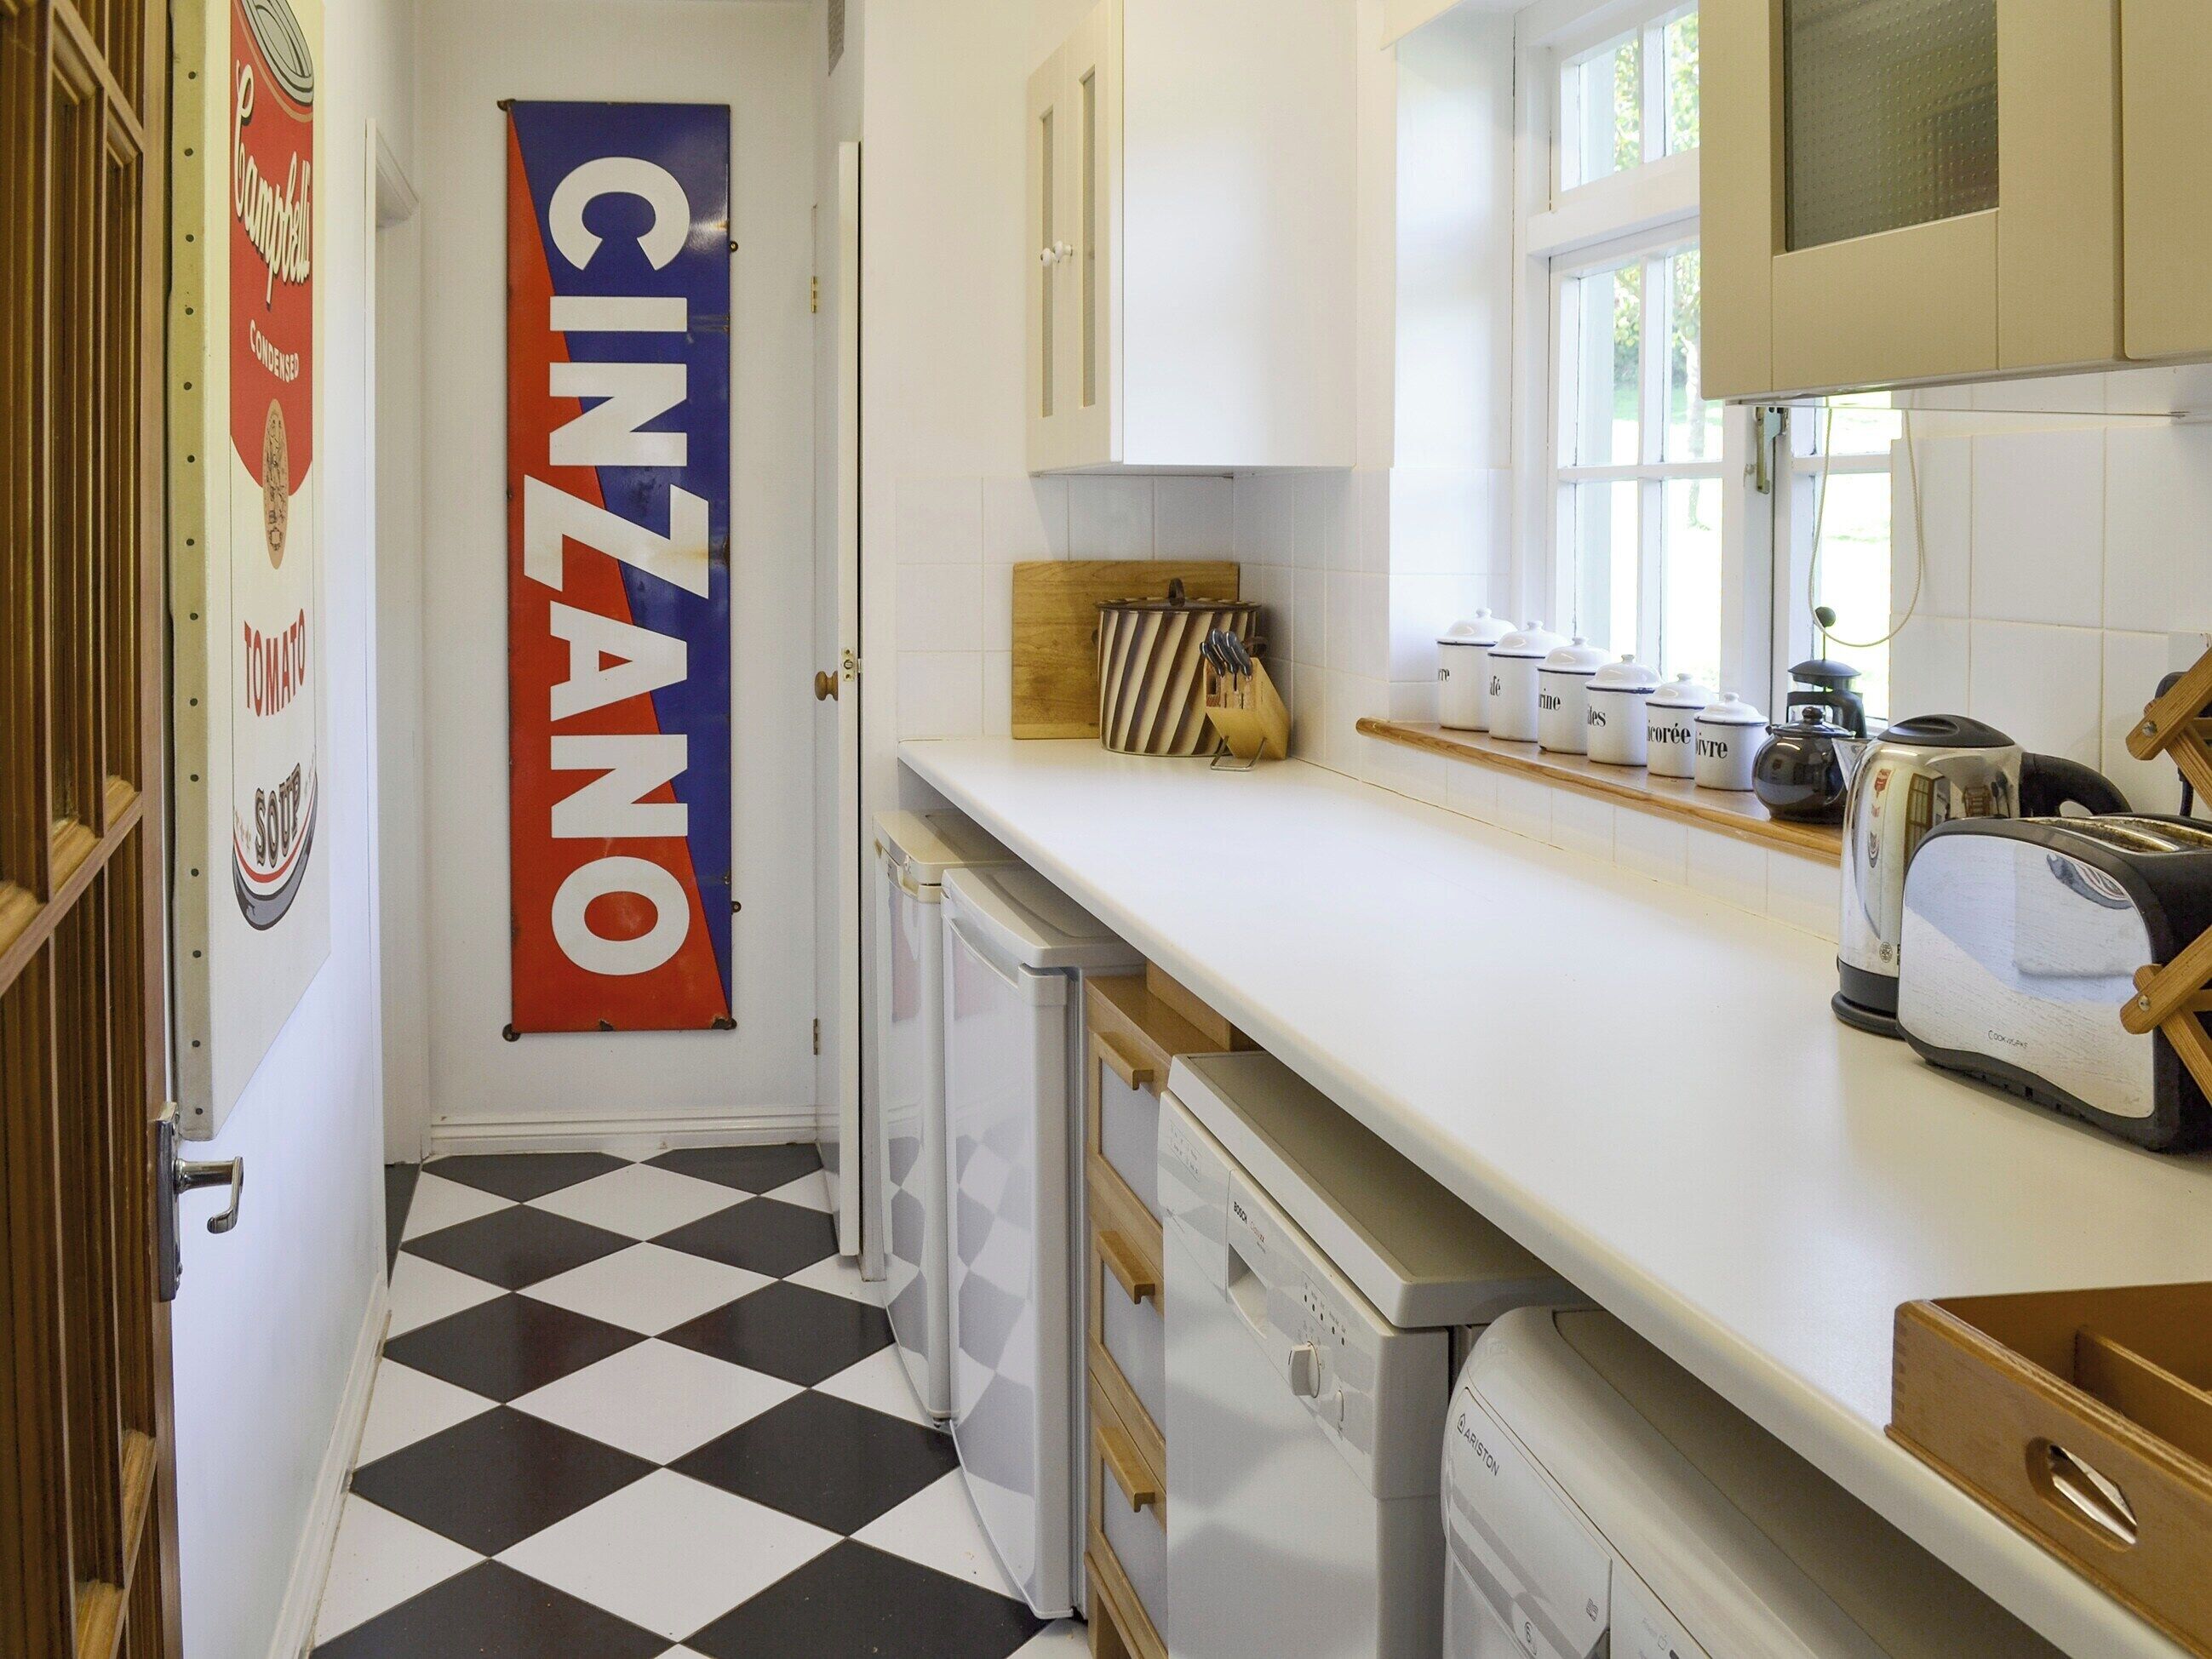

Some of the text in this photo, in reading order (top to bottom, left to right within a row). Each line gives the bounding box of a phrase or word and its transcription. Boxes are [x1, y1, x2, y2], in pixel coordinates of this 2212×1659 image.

[249, 319, 300, 383] CONDENSED
[524, 156, 709, 975] CINZANO
[244, 608, 306, 717] TOMATO
[255, 762, 301, 869] SOUP
[1234, 1201, 1248, 1224] BOSCH
[1464, 1427, 1500, 1477] ARISTON
